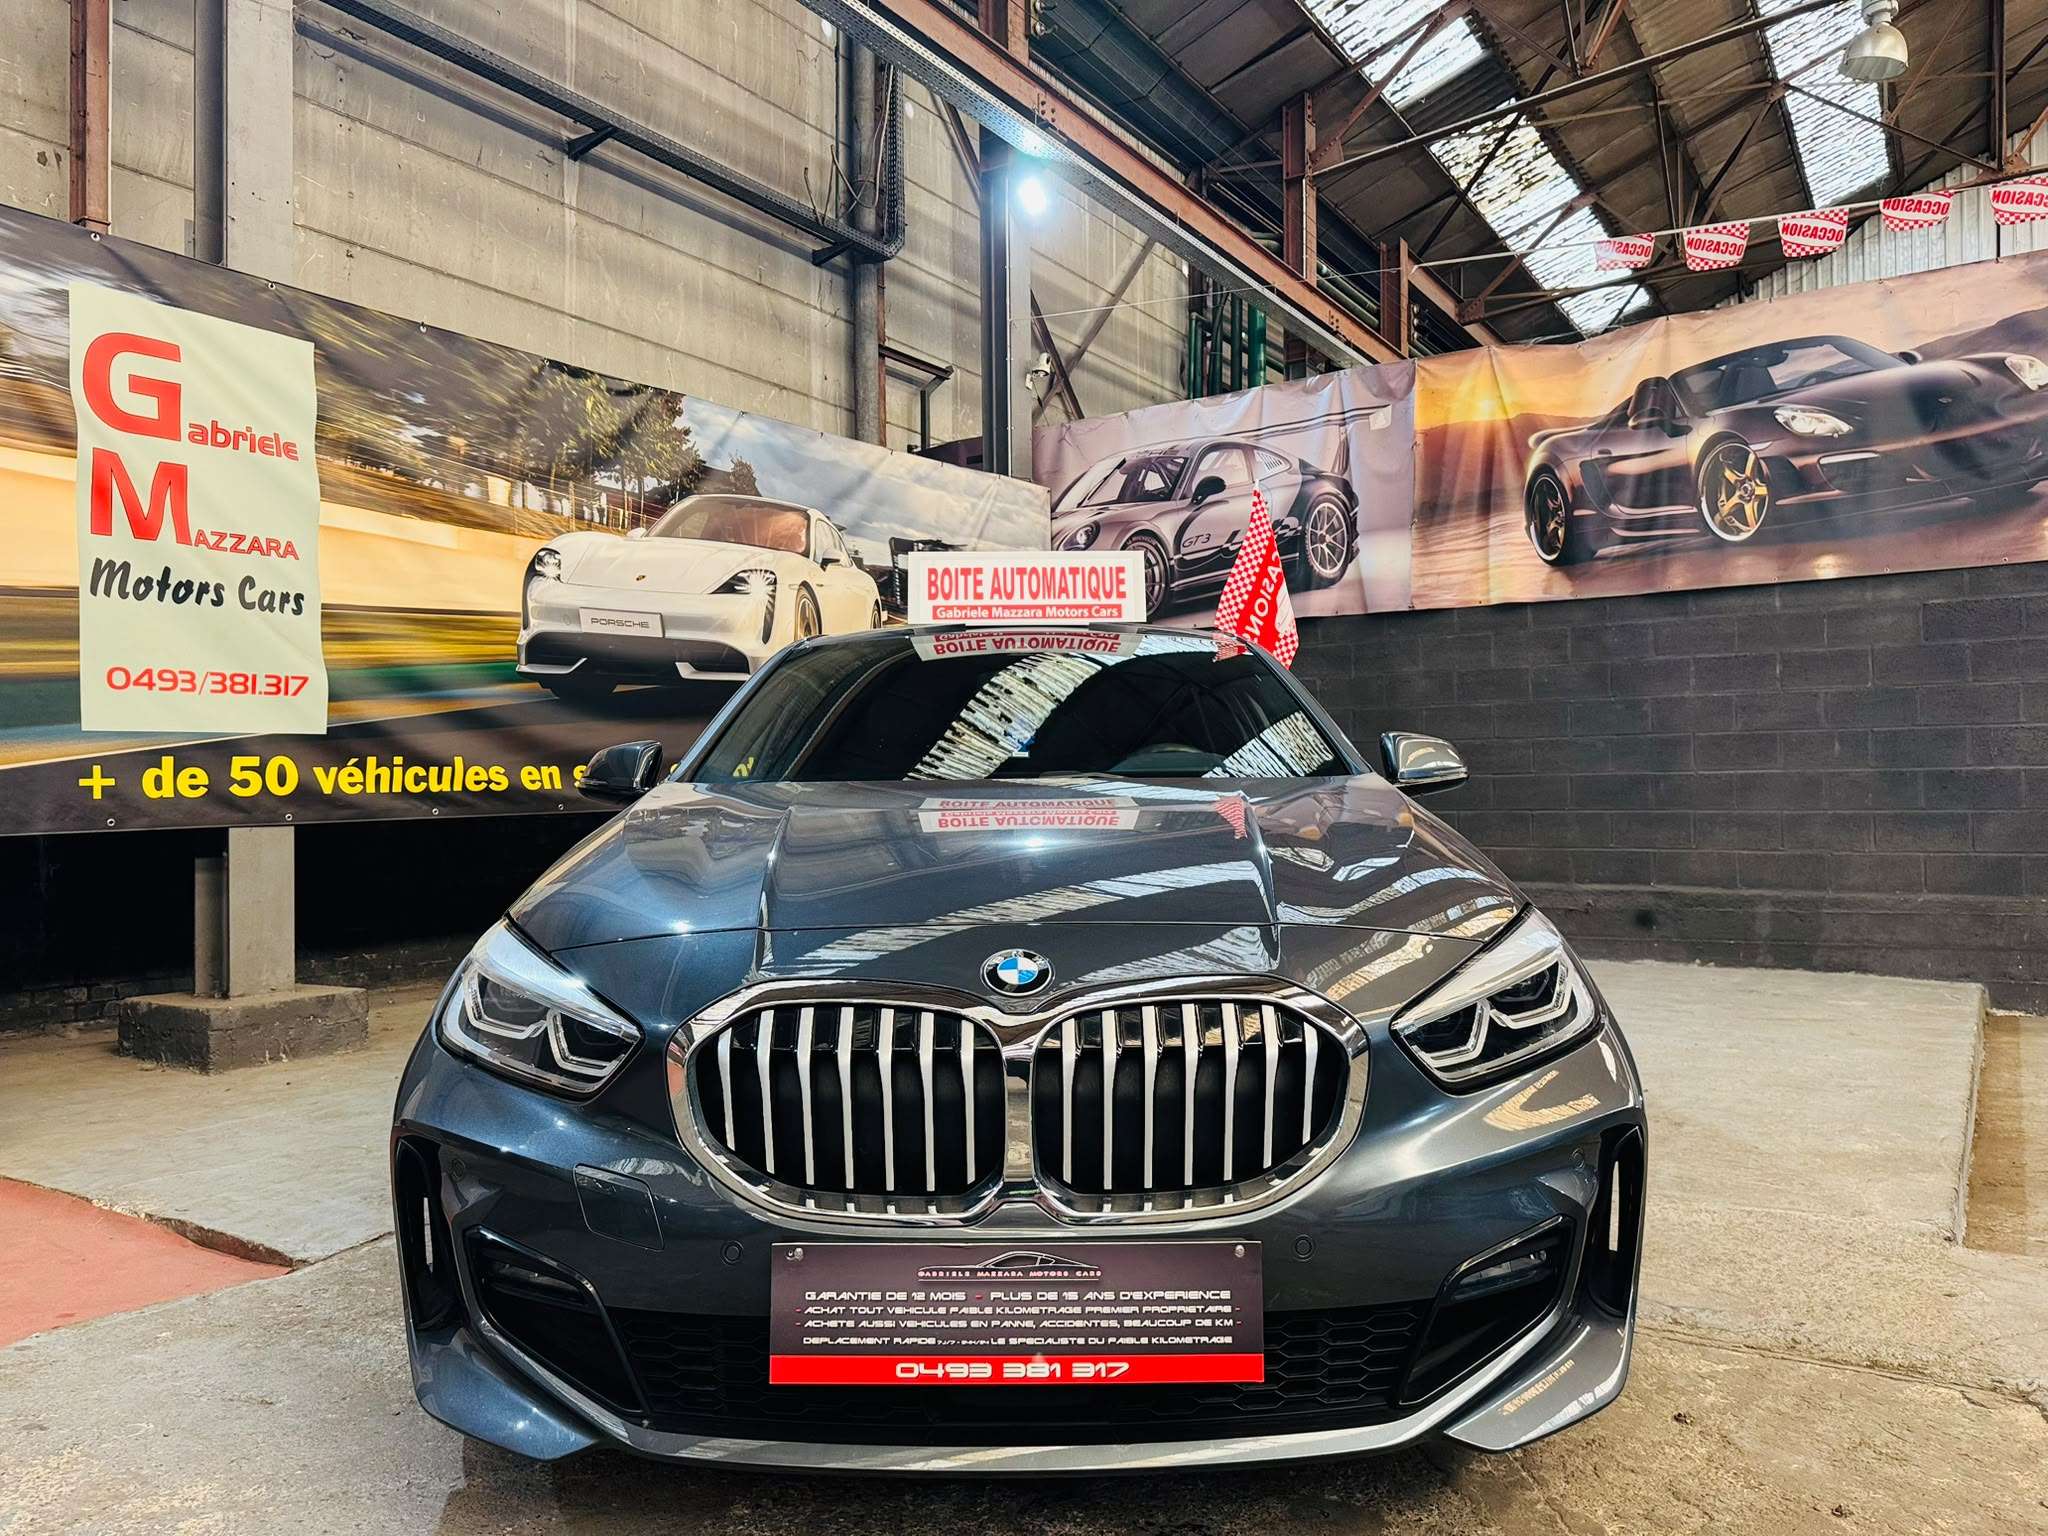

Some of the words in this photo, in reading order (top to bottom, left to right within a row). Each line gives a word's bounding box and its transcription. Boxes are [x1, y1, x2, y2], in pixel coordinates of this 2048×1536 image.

[1182, 533, 1212, 548] GT3
[89, 557, 225, 607] Motors
[238, 575, 305, 616] Cars
[928, 567, 984, 601] BOITE
[990, 566, 1127, 602] AUTOMATIQUE
[936, 607, 990, 619] Gabriele
[992, 607, 1043, 619] Mazzara
[1046, 606, 1089, 618] Motors
[1092, 605, 1119, 617] Cars
[590, 617, 650, 629] PORSCHE
[106, 666, 310, 697] 0493/381.317
[142, 755, 209, 799] de
[228, 755, 299, 797] 50
[312, 755, 509, 795] véhicules
[520, 763, 562, 790] en
[805, 1291, 882, 1301] GARANTIE
[886, 1291, 907, 1301] DE
[911, 1291, 926, 1301] 12
[929, 1291, 966, 1301] MOIS
[990, 1291, 1033, 1301] PLUS
[1036, 1291, 1058, 1301] DE
[1083, 1291, 1116, 1301] ANS
[1119, 1290, 1231, 1300] D'EXPERIENCE
[803, 1306, 846, 1314] ACHAT
[849, 1306, 885, 1314] TOUT
[887, 1306, 947, 1314] VEHICULE
[950, 1306, 993, 1314] FAIBLE
[995, 1306, 1082, 1314] KILOMETRAGE
[1085, 1306, 1139, 1314] PREMIER
[1142, 1305, 1232, 1314] PROPRIETAIRE
[803, 1320, 855, 1328] ACHETE
[858, 1320, 896, 1328] AUSSI
[899, 1320, 967, 1328] VEHICULES
[971, 1320, 988, 1328] EN
[991, 1320, 1036, 1329] PANNE,
[1039, 1320, 1121, 1329] ACCIDENTES,
[1123, 1319, 1192, 1328] BEAUCOUP
[1195, 1319, 1213, 1327] DE
[1215, 1318, 1234, 1327] KM
[803, 1337, 890, 1345] DEPLACEMENT
[894, 1337, 936, 1345] RAPIDE
[990, 1337, 1006, 1345] LE
[1008, 1336, 1086, 1345] SPECIALISTE
[1088, 1336, 1105, 1345] DU
[1108, 1336, 1149, 1345] FAIBLE
[1151, 1335, 1233, 1344] KILOMETRAGE
[895, 1362, 993, 1379] 0493
[1002, 1361, 1062, 1379] 381
[1071, 1361, 1130, 1378] 317
